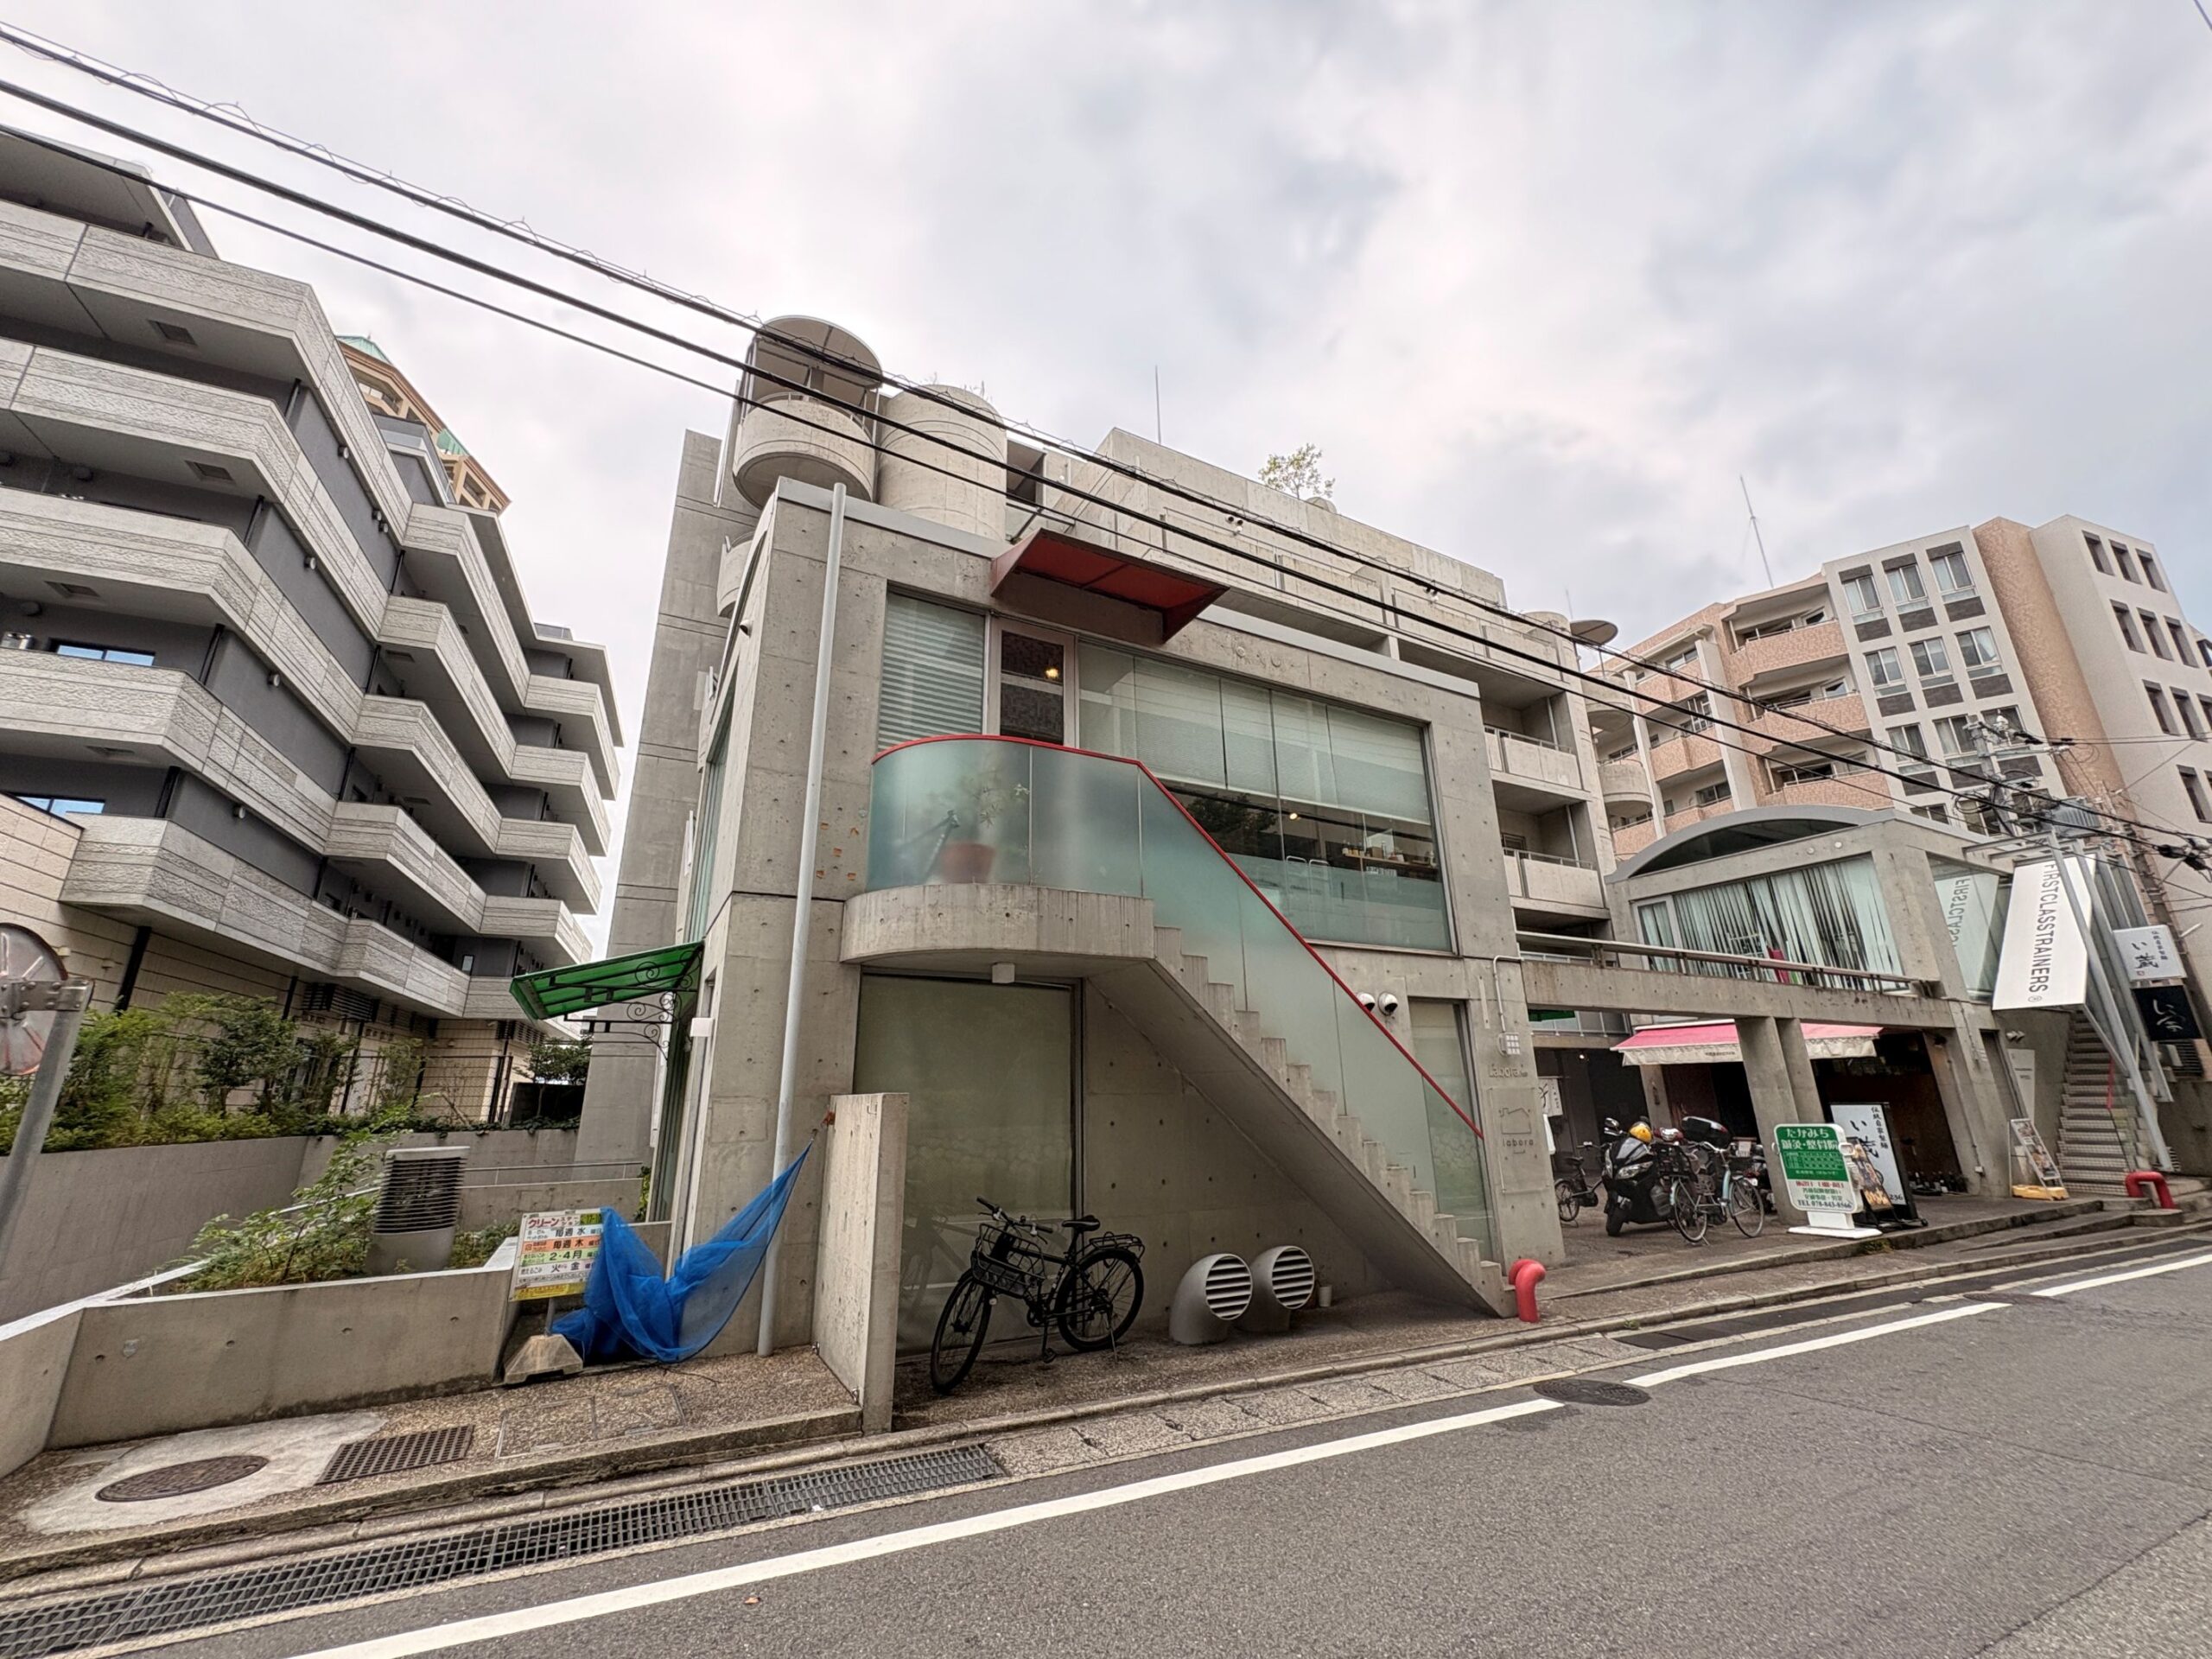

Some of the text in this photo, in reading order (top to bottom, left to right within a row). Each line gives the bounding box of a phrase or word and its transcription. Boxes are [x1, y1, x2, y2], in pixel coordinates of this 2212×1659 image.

[2028, 864, 2061, 993] FIRSTCLASSTRAINERS
[528, 1217, 560, 1228] クリーン
